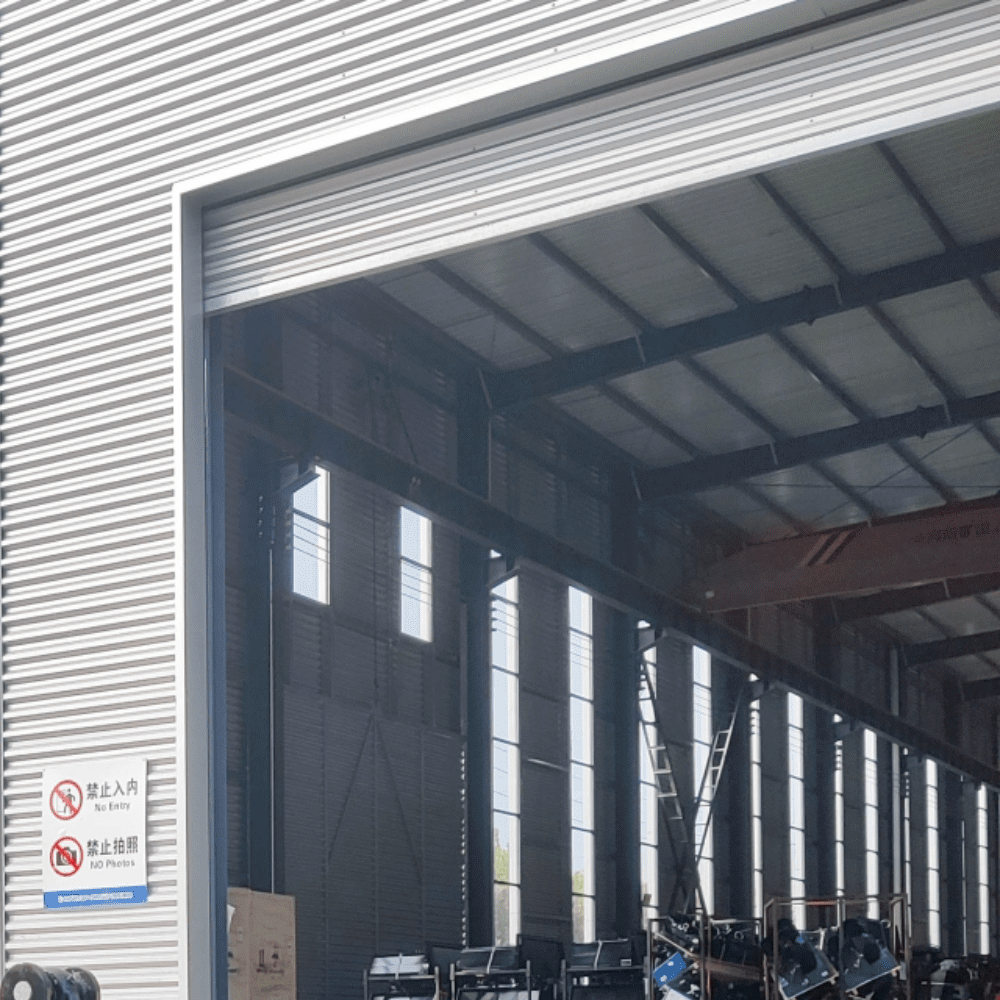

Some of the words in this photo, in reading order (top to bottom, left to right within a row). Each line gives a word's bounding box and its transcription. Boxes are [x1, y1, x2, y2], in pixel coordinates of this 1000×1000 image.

[86, 777, 138, 800] 禁止入内
[94, 802, 107, 812] No
[109, 801, 131, 811] Entry
[86, 835, 138, 857] 禁止拍照
[90, 860, 104, 869] NO
[106, 859, 136, 868] Photos
